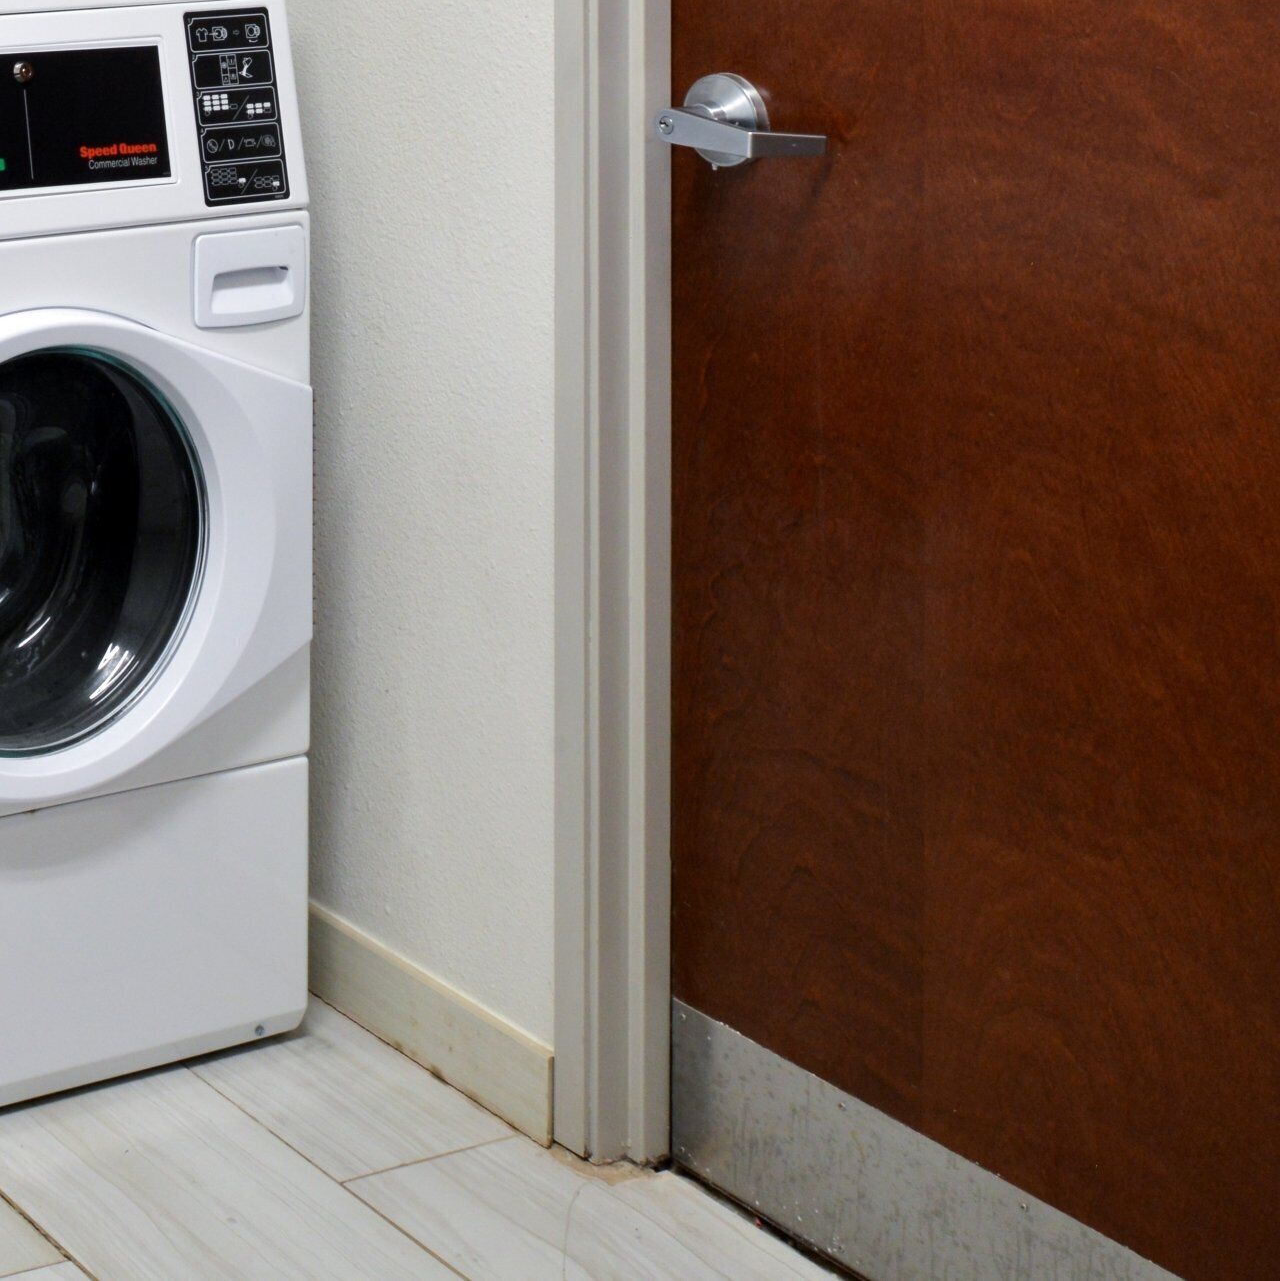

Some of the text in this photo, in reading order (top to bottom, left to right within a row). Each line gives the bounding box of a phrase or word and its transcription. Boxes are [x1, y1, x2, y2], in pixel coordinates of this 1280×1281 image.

[80, 142, 157, 159] Speed Queen
[88, 155, 158, 170] Commercial Washer
